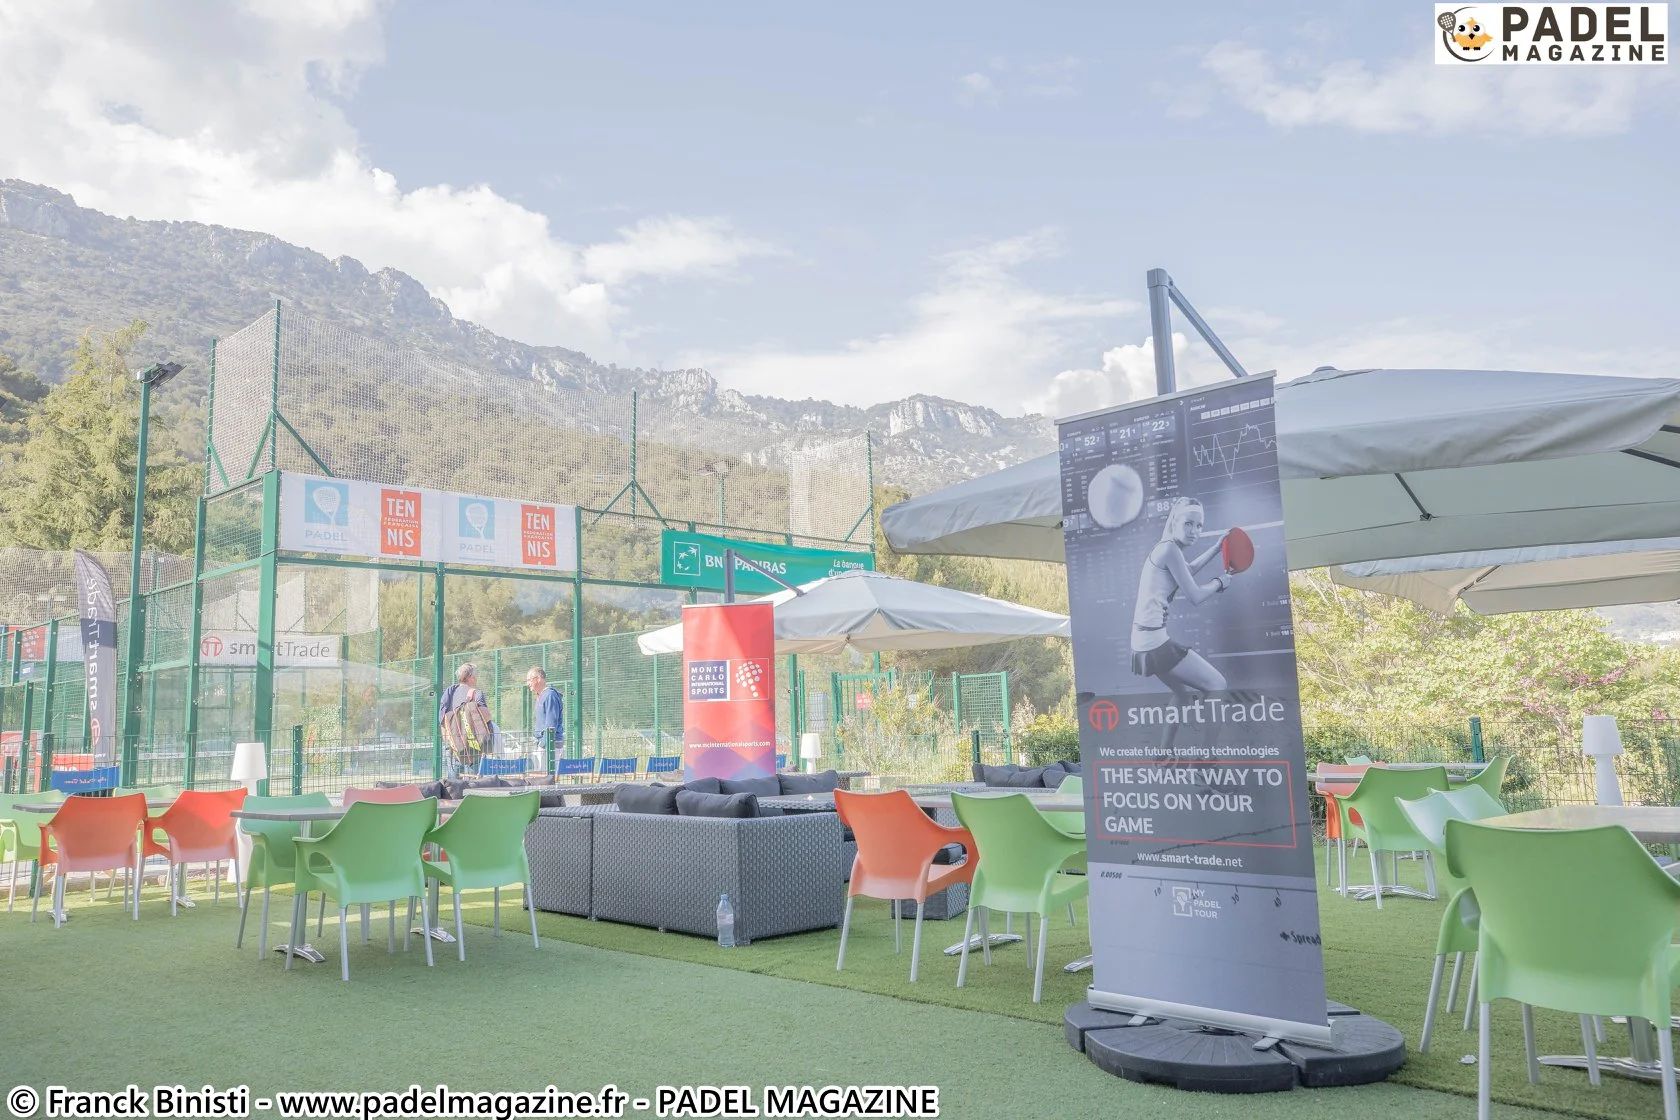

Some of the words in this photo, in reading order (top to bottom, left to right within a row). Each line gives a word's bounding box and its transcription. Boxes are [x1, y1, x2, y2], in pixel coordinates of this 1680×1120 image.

[386, 497, 415, 518] TEN
[526, 512, 550, 530] TEN
[305, 529, 348, 542] PADEL
[387, 529, 415, 548] NIS
[460, 543, 495, 554] PADEL
[527, 540, 551, 558] NIS
[705, 554, 725, 569] BN
[229, 641, 330, 658] smtTrade
[691, 687, 725, 695] SPORTS
[1127, 695, 1285, 725] smartTrade
[1100, 747, 1116, 757] We
[1117, 748, 1144, 757] create
[1144, 747, 1173, 757] future
[1173, 746, 1210, 759] trading
[1211, 746, 1280, 759] technologies
[1101, 767, 1134, 784] THE
[1137, 768, 1197, 785] SMART
[1202, 768, 1249, 786] WAY
[1253, 768, 1283, 786] TO
[1103, 792, 1160, 809] FOCUS
[1164, 793, 1193, 811] ON
[1196, 794, 1253, 812] YOUR
[1104, 816, 1154, 834] GAME
[1137, 851, 1244, 868] www.smart-trade.net
[1193, 889, 1206, 897] MY
[1194, 900, 1221, 909] PADEL
[1194, 909, 1218, 919] TOUR
[1290, 930, 1322, 946] Spread
